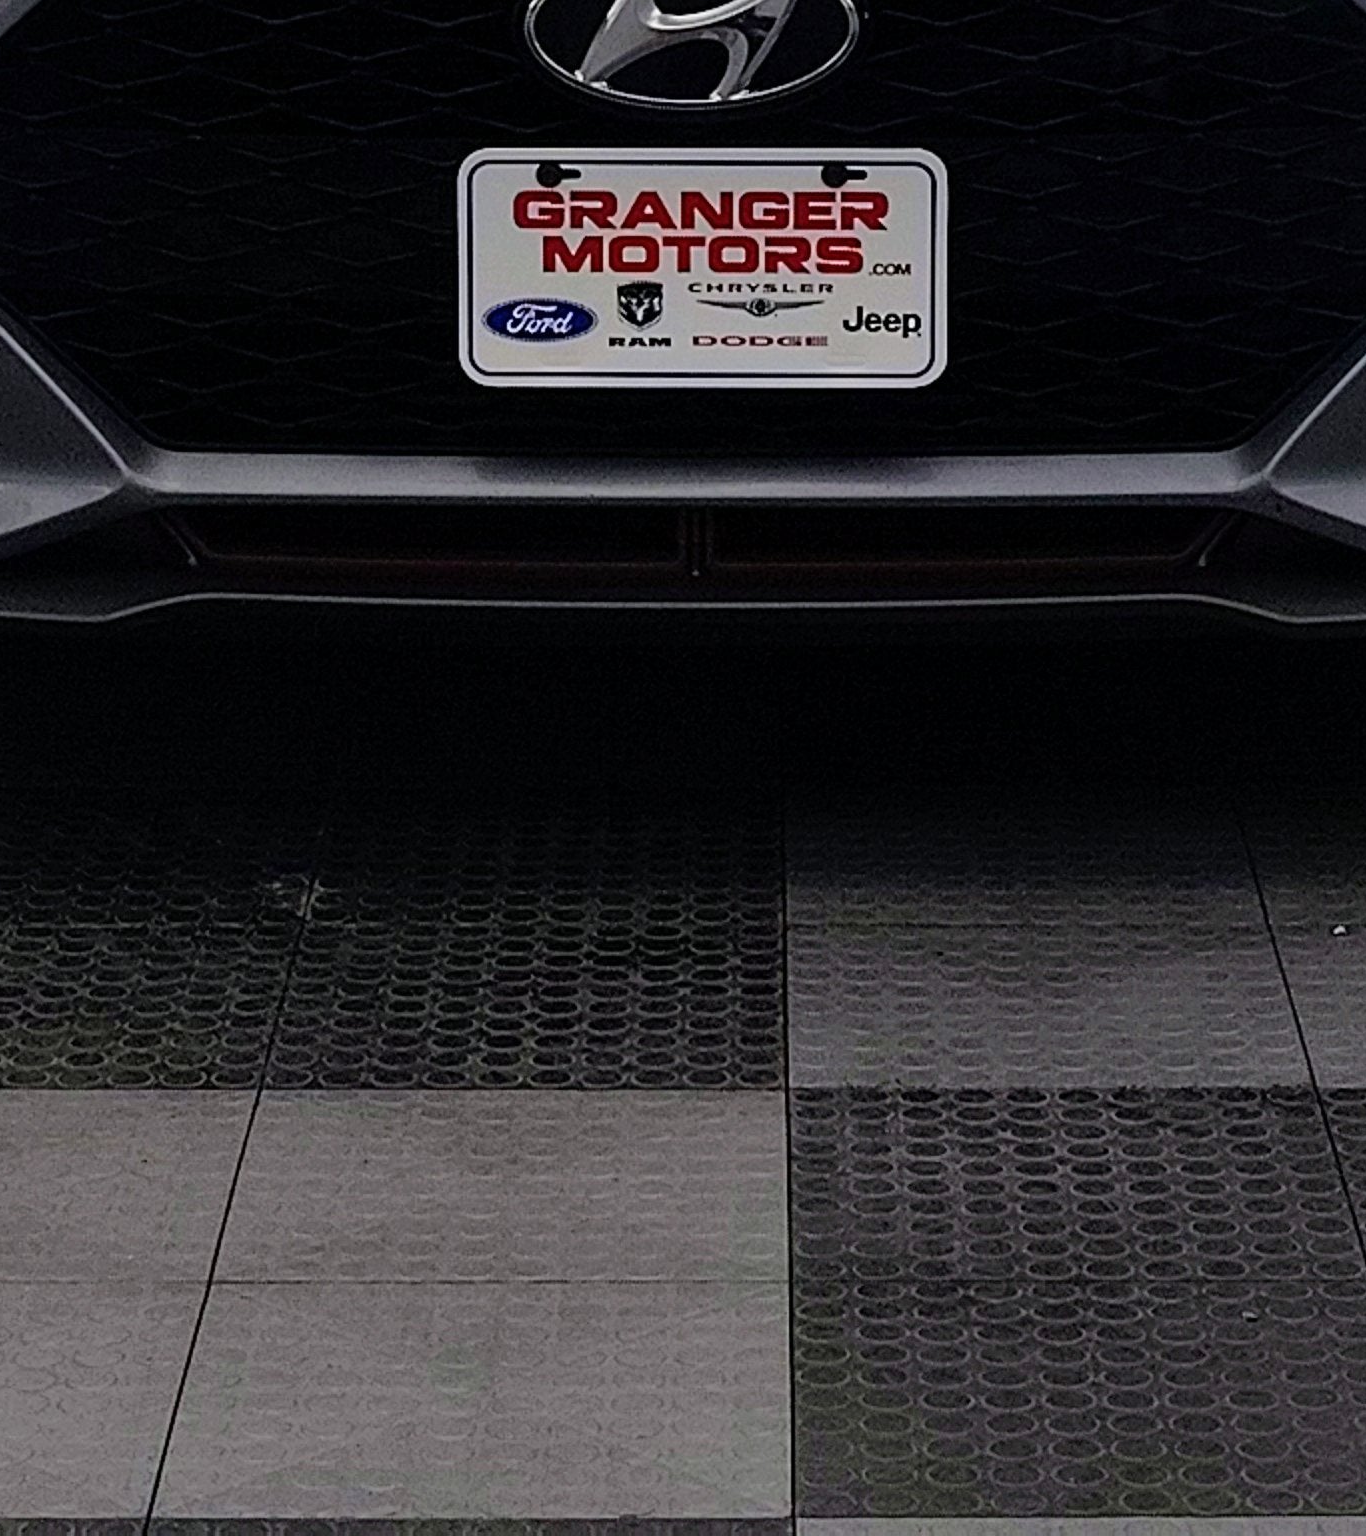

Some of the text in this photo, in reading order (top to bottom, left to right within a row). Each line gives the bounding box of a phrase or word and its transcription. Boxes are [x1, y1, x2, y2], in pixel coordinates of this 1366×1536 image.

[512, 189, 890, 231] GRANGER
[542, 235, 912, 277] MOTORS .COM
[687, 282, 834, 294] CHRYSLER
[506, 303, 574, 334] Ford
[842, 305, 922, 339] Jeep
[608, 336, 672, 348] RAM
[692, 335, 829, 347] DODGE
